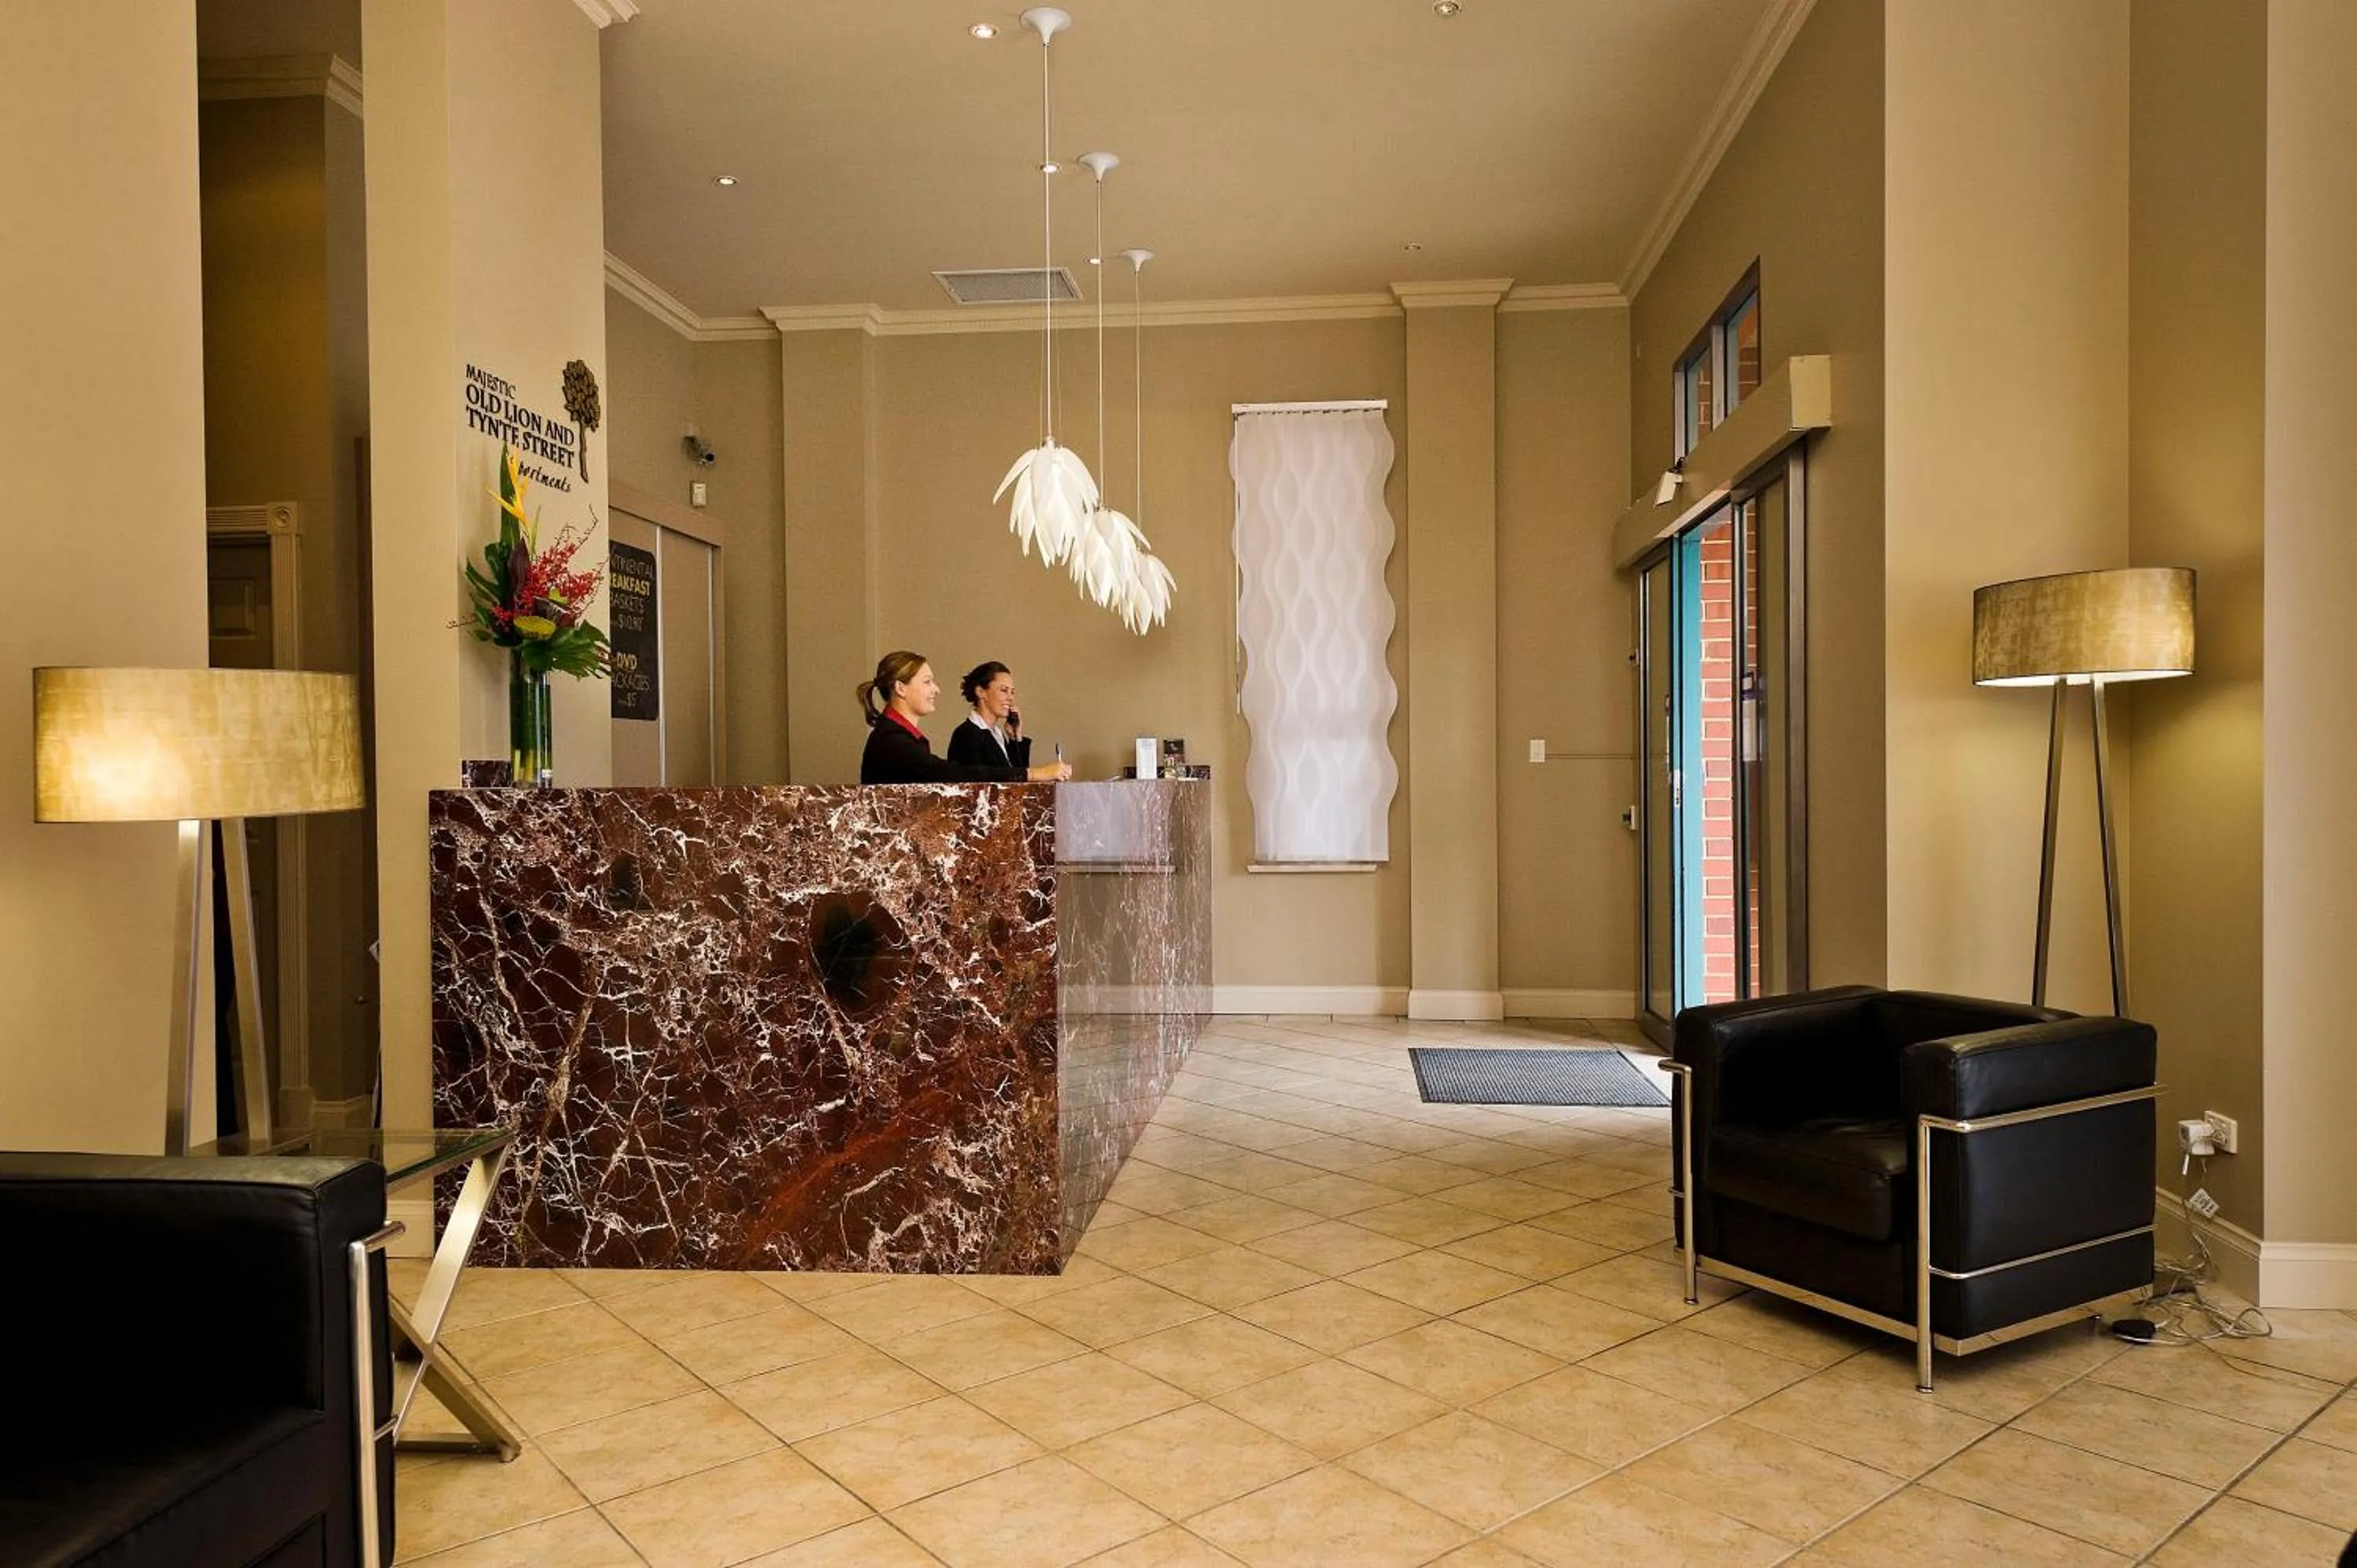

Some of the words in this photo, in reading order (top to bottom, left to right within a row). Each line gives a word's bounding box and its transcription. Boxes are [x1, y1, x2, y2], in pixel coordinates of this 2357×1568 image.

[465, 364, 516, 400] MAJESTIC
[466, 384, 501, 414] OLD
[504, 400, 541, 434] LION
[544, 419, 574, 446] AND
[465, 405, 519, 448] TYNTE
[522, 432, 574, 469] STREET
[518, 460, 572, 493] partments
[610, 573, 651, 596] EAKFAST
[617, 651, 637, 670] DVD
